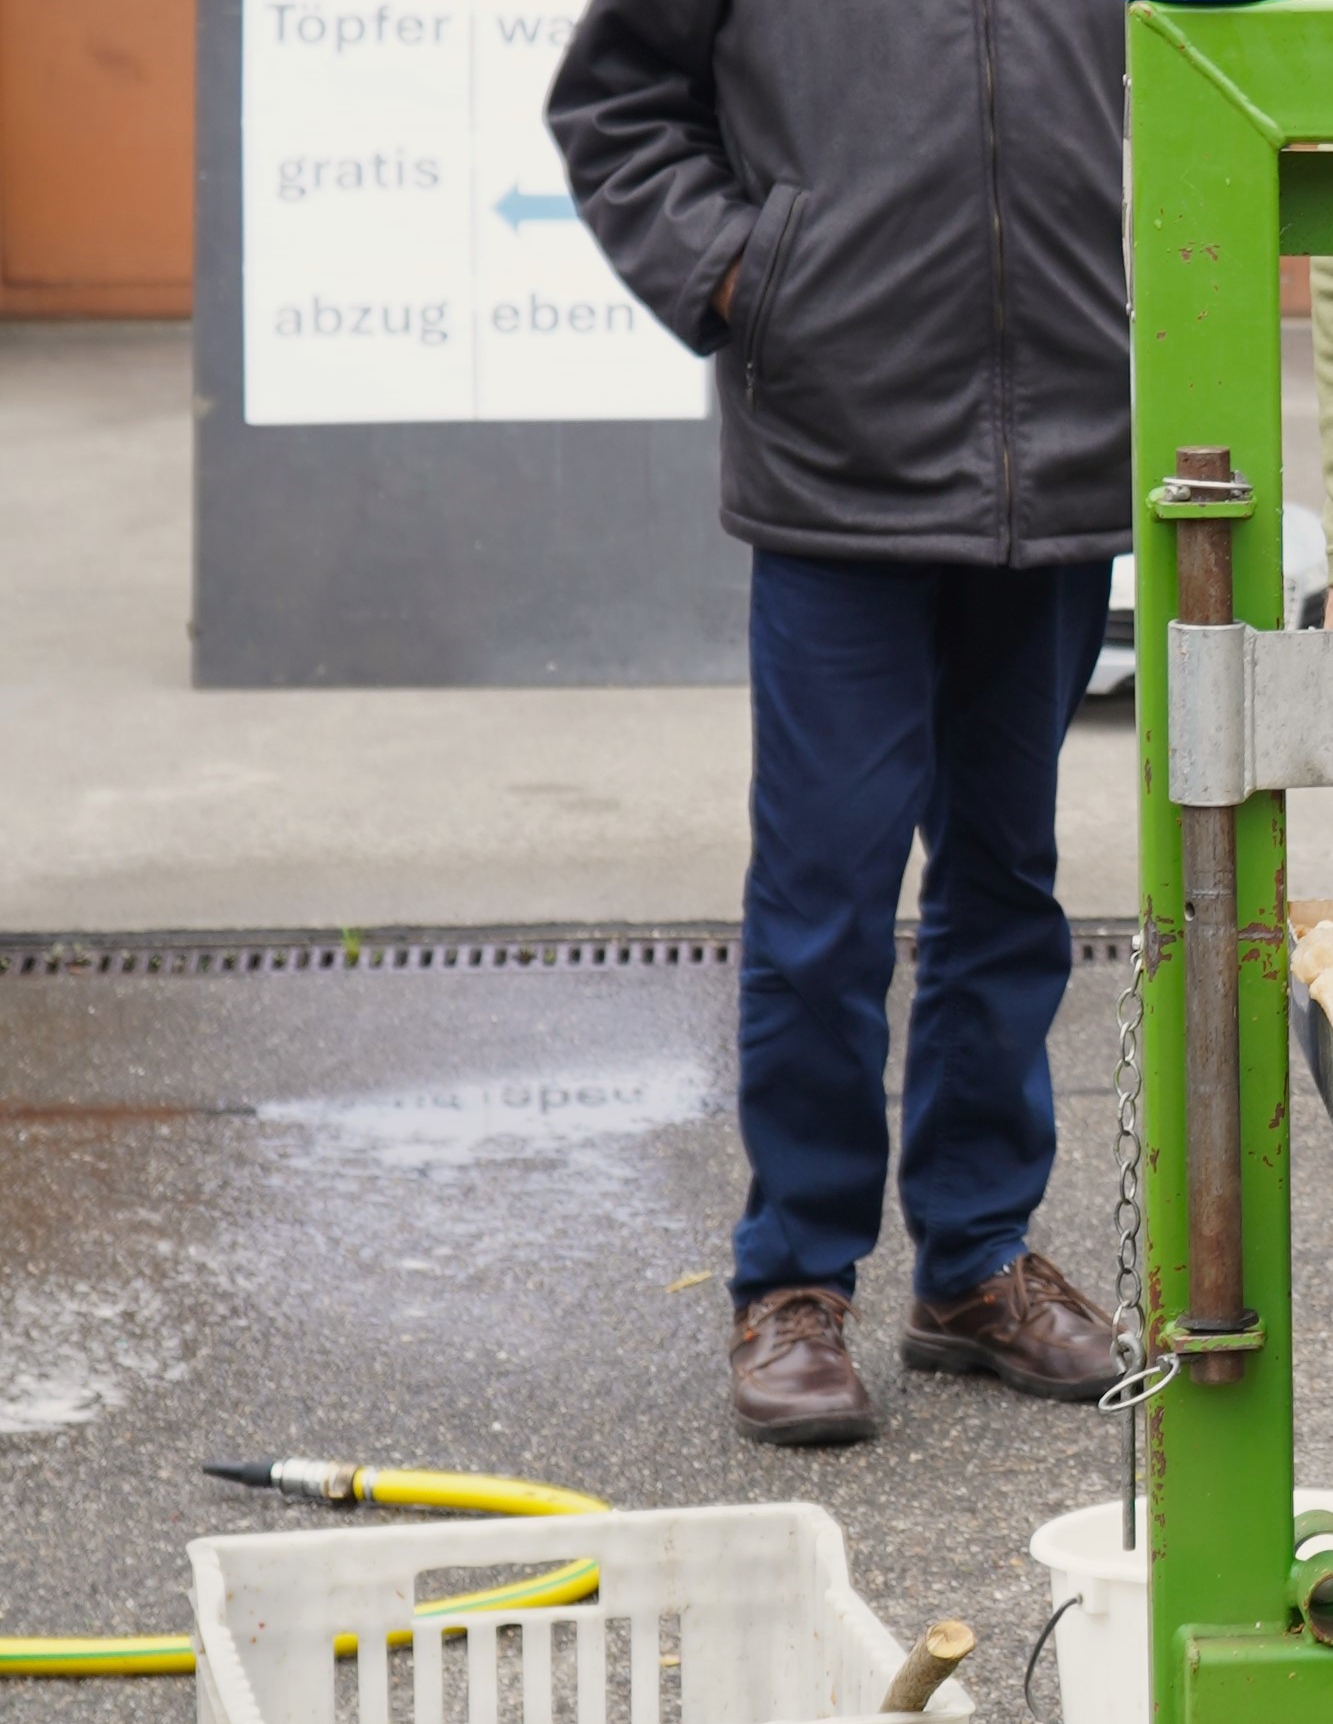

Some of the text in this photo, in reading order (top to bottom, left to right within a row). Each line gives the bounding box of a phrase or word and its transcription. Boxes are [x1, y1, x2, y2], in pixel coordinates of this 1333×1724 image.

[271, 2, 451, 52] Töpfer
[277, 147, 441, 204] gratis
[274, 291, 637, 348] abzug eben
